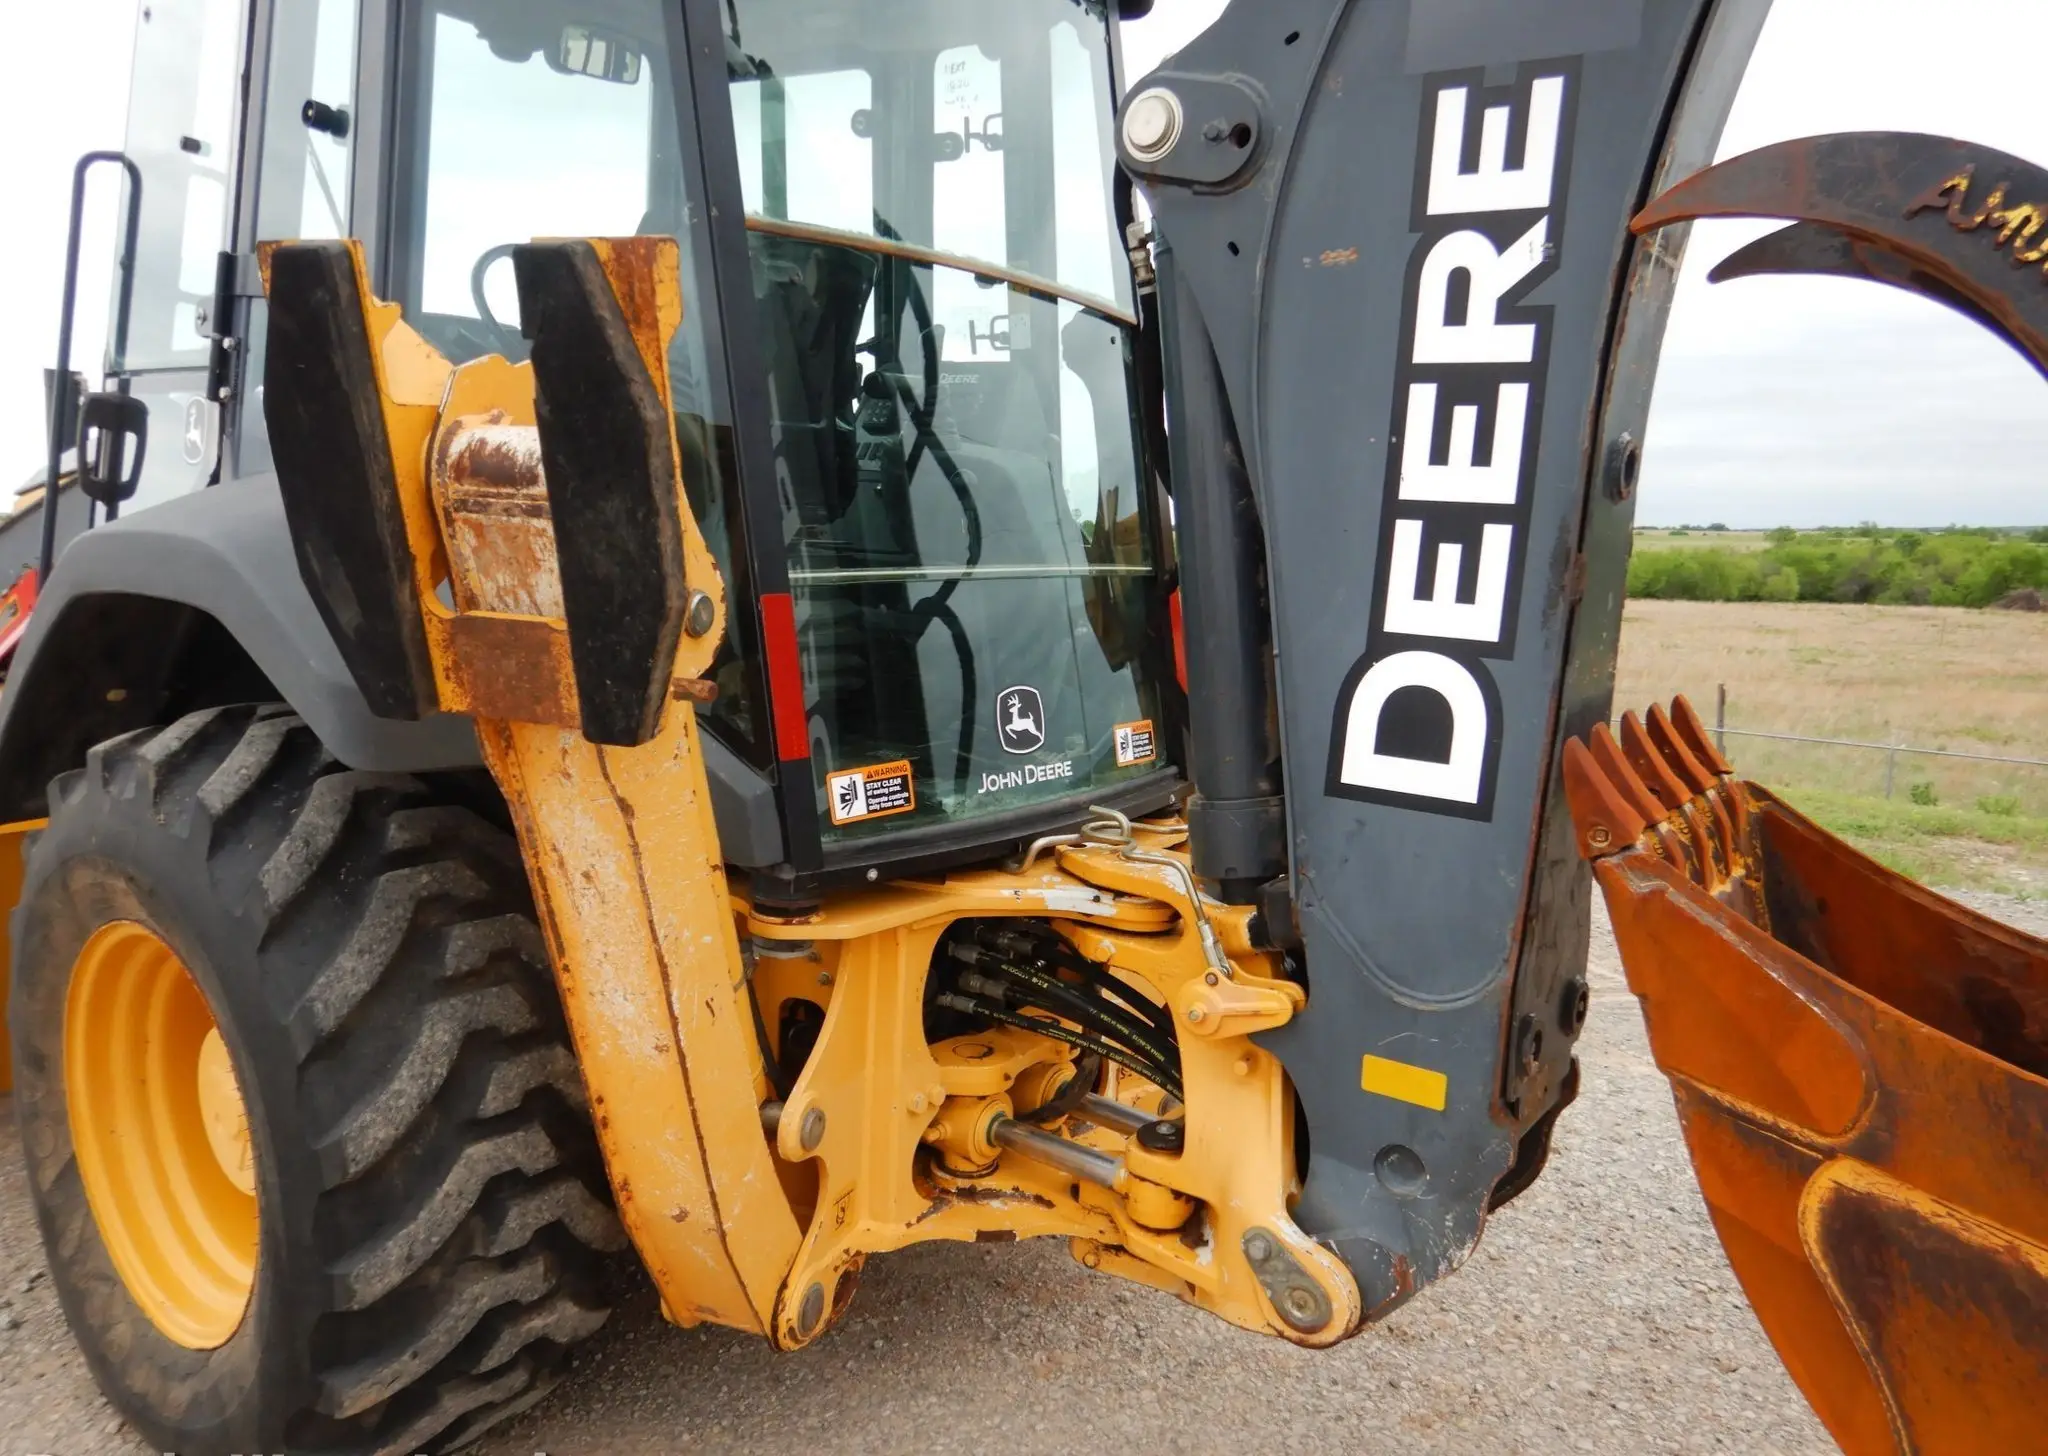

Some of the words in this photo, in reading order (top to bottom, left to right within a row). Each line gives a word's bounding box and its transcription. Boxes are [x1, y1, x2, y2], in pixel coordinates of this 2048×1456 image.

[940, 373, 979, 384] DEERE
[1340, 75, 1564, 804] DEERE
[873, 764, 908, 777] WARNING
[977, 769, 1023, 794] JOHN
[1024, 760, 1073, 784] DEERE
[865, 782, 882, 791] STAY
[882, 777, 902, 787] CLEAR
